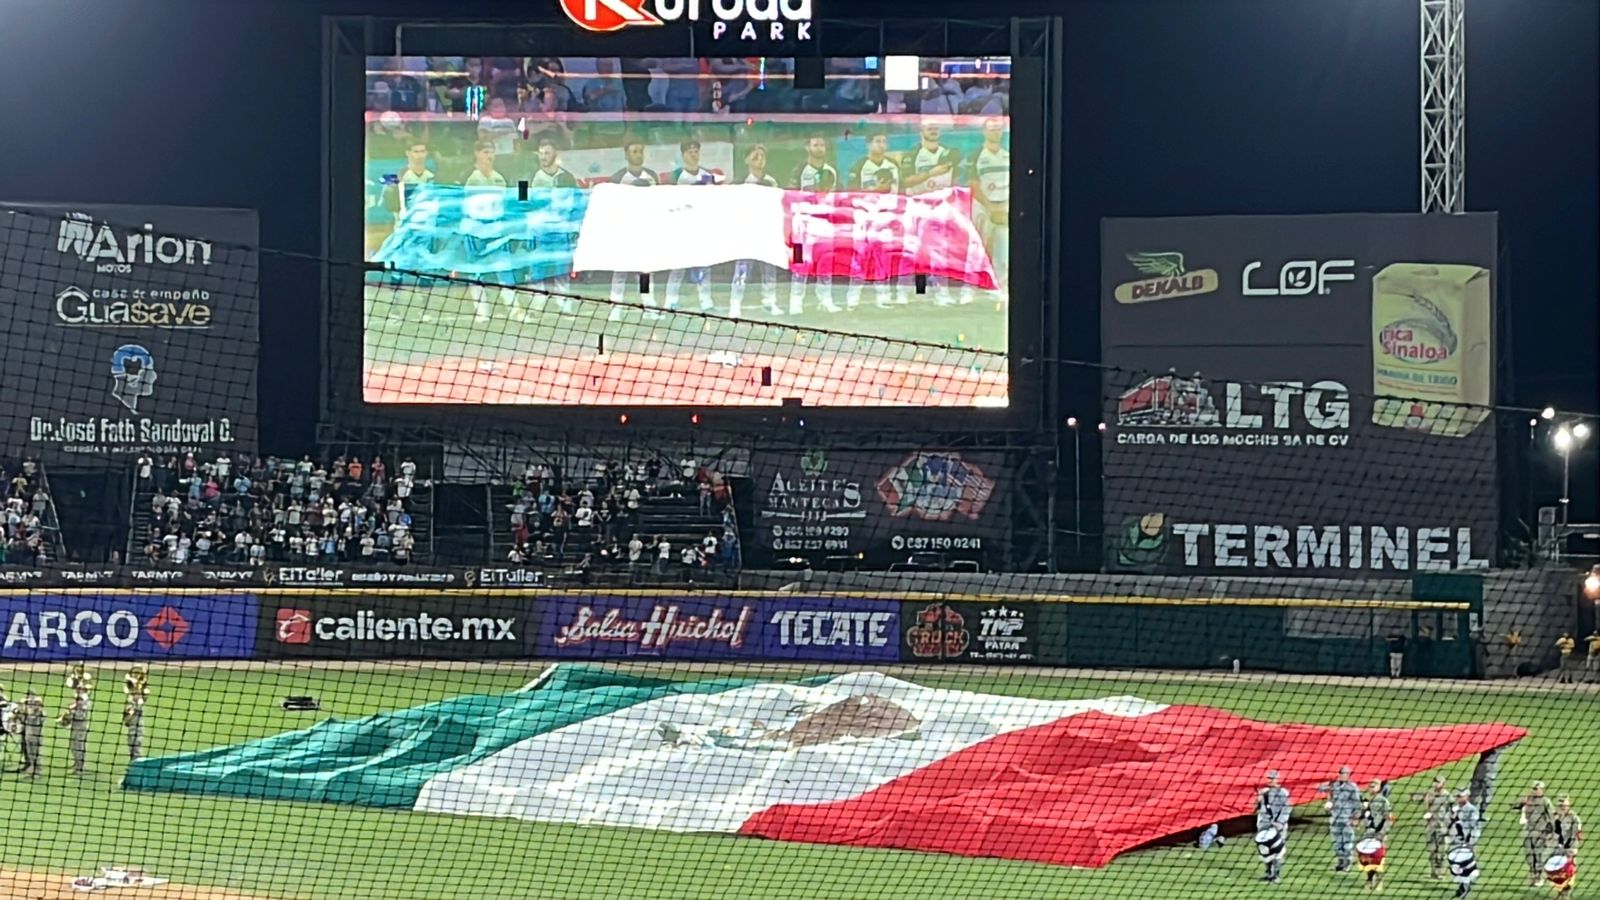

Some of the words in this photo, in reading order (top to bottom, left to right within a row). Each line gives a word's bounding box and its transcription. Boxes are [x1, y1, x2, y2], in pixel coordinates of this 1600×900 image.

[713, 22, 812, 40] PARK
[86, 220, 212, 265] Arion
[97, 264, 132, 274] MOTOS
[1383, 329, 1413, 342] rica
[1383, 341, 1447, 360] Sinaloa
[1226, 380, 1350, 429] LTG
[140, 418, 215, 443] Sandoval
[1117, 433, 1165, 445] CARGA
[1169, 434, 1188, 445] DE
[1191, 434, 1219, 446] LOS
[1222, 434, 1279, 446] MOCHIS
[1283, 434, 1301, 446] SA
[1306, 435, 1325, 446] DE
[1328, 435, 1349, 446] CV
[1172, 522, 1490, 571] TERMINEL
[3, 610, 140, 648] ARCO
[315, 610, 516, 641] caliente.mx
[554, 605, 639, 647] Salsa
[640, 605, 750, 648] Huichol
[771, 610, 893, 647] TECATE
